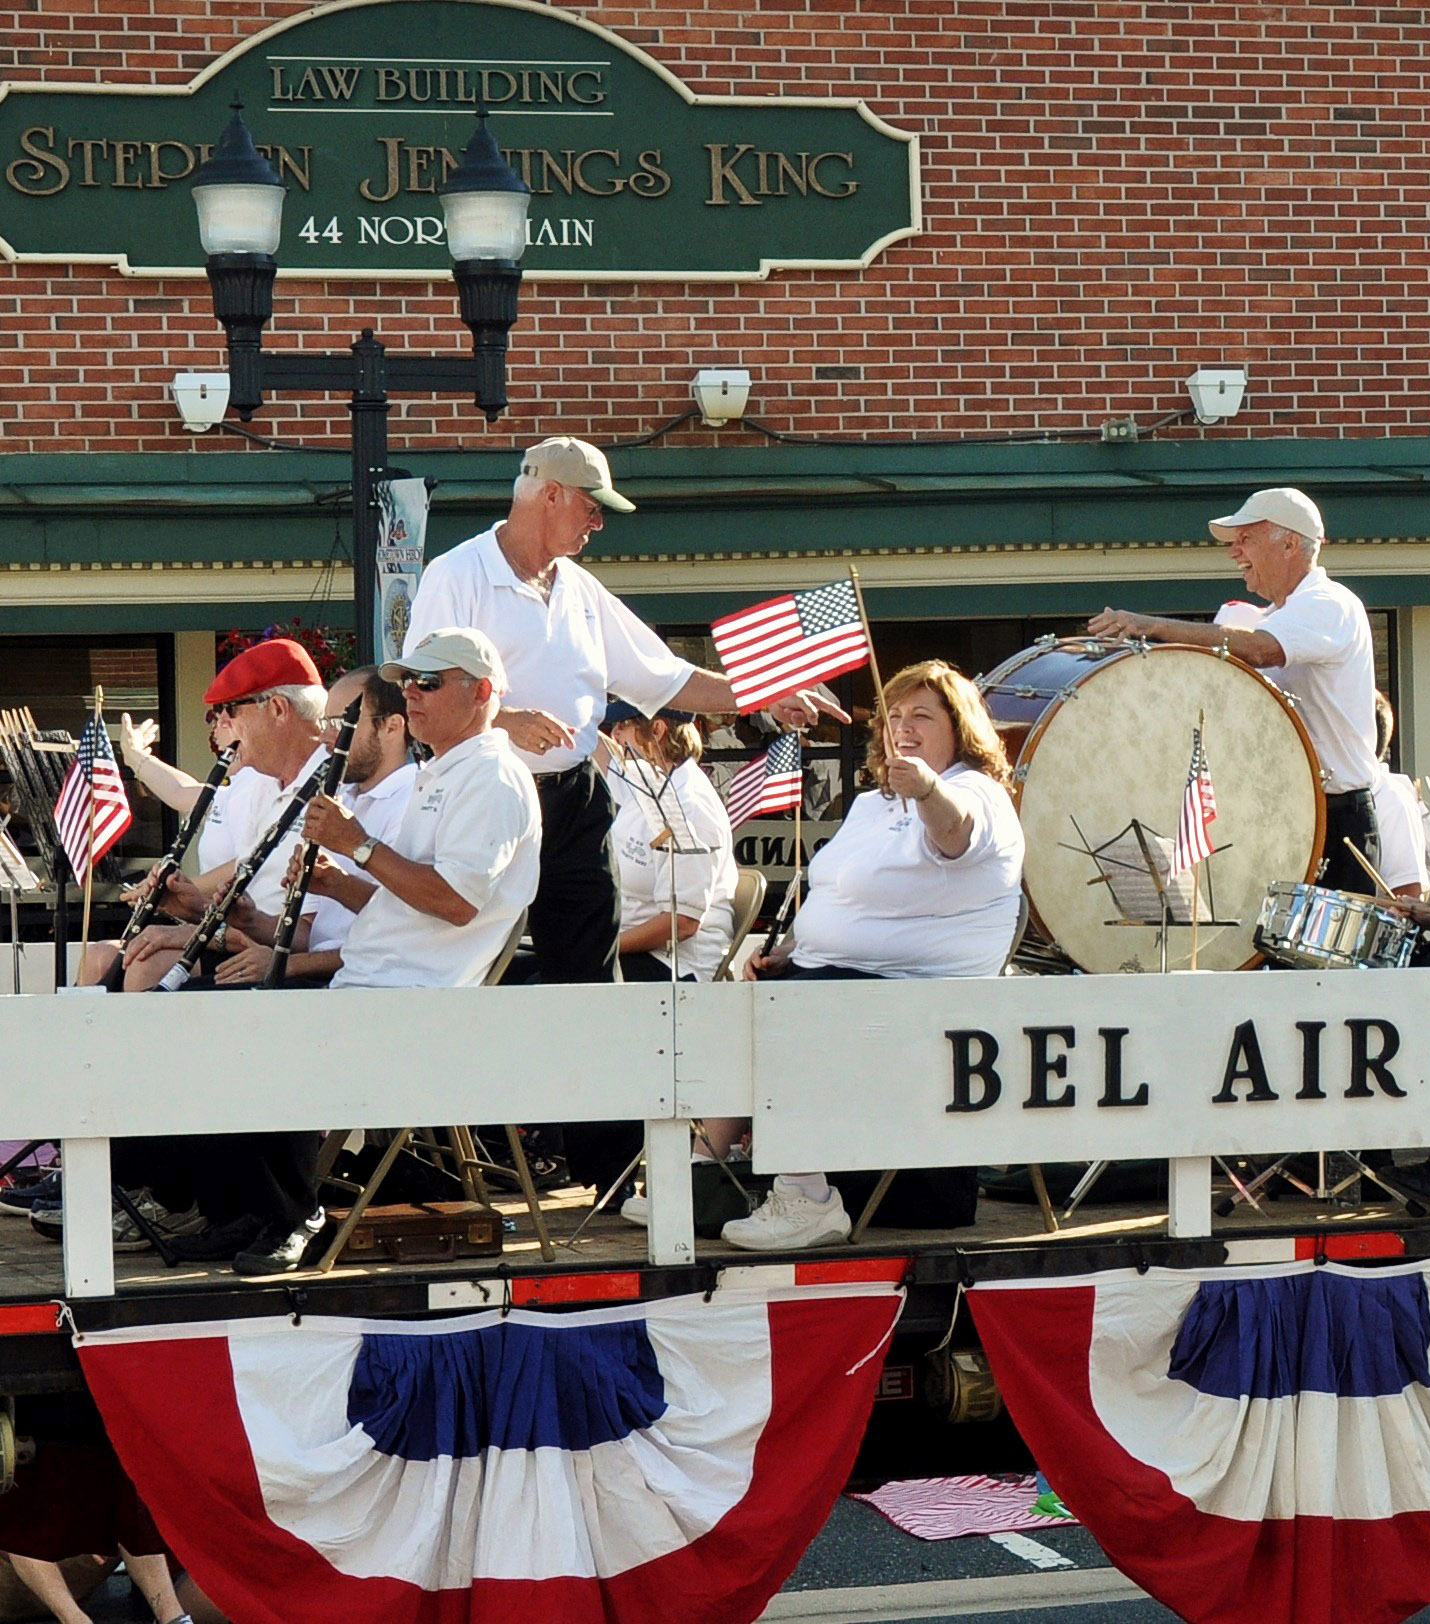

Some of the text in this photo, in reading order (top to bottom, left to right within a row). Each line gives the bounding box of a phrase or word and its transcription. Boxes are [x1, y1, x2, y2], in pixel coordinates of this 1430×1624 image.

[269, 66, 607, 106] LAW BUILDING
[5, 126, 860, 206] STEPN JEINGS KING
[297, 215, 595, 247] 44 NOR AIN
[944, 1025, 1150, 1113] BEL
[1210, 1018, 1408, 1103] AIR
